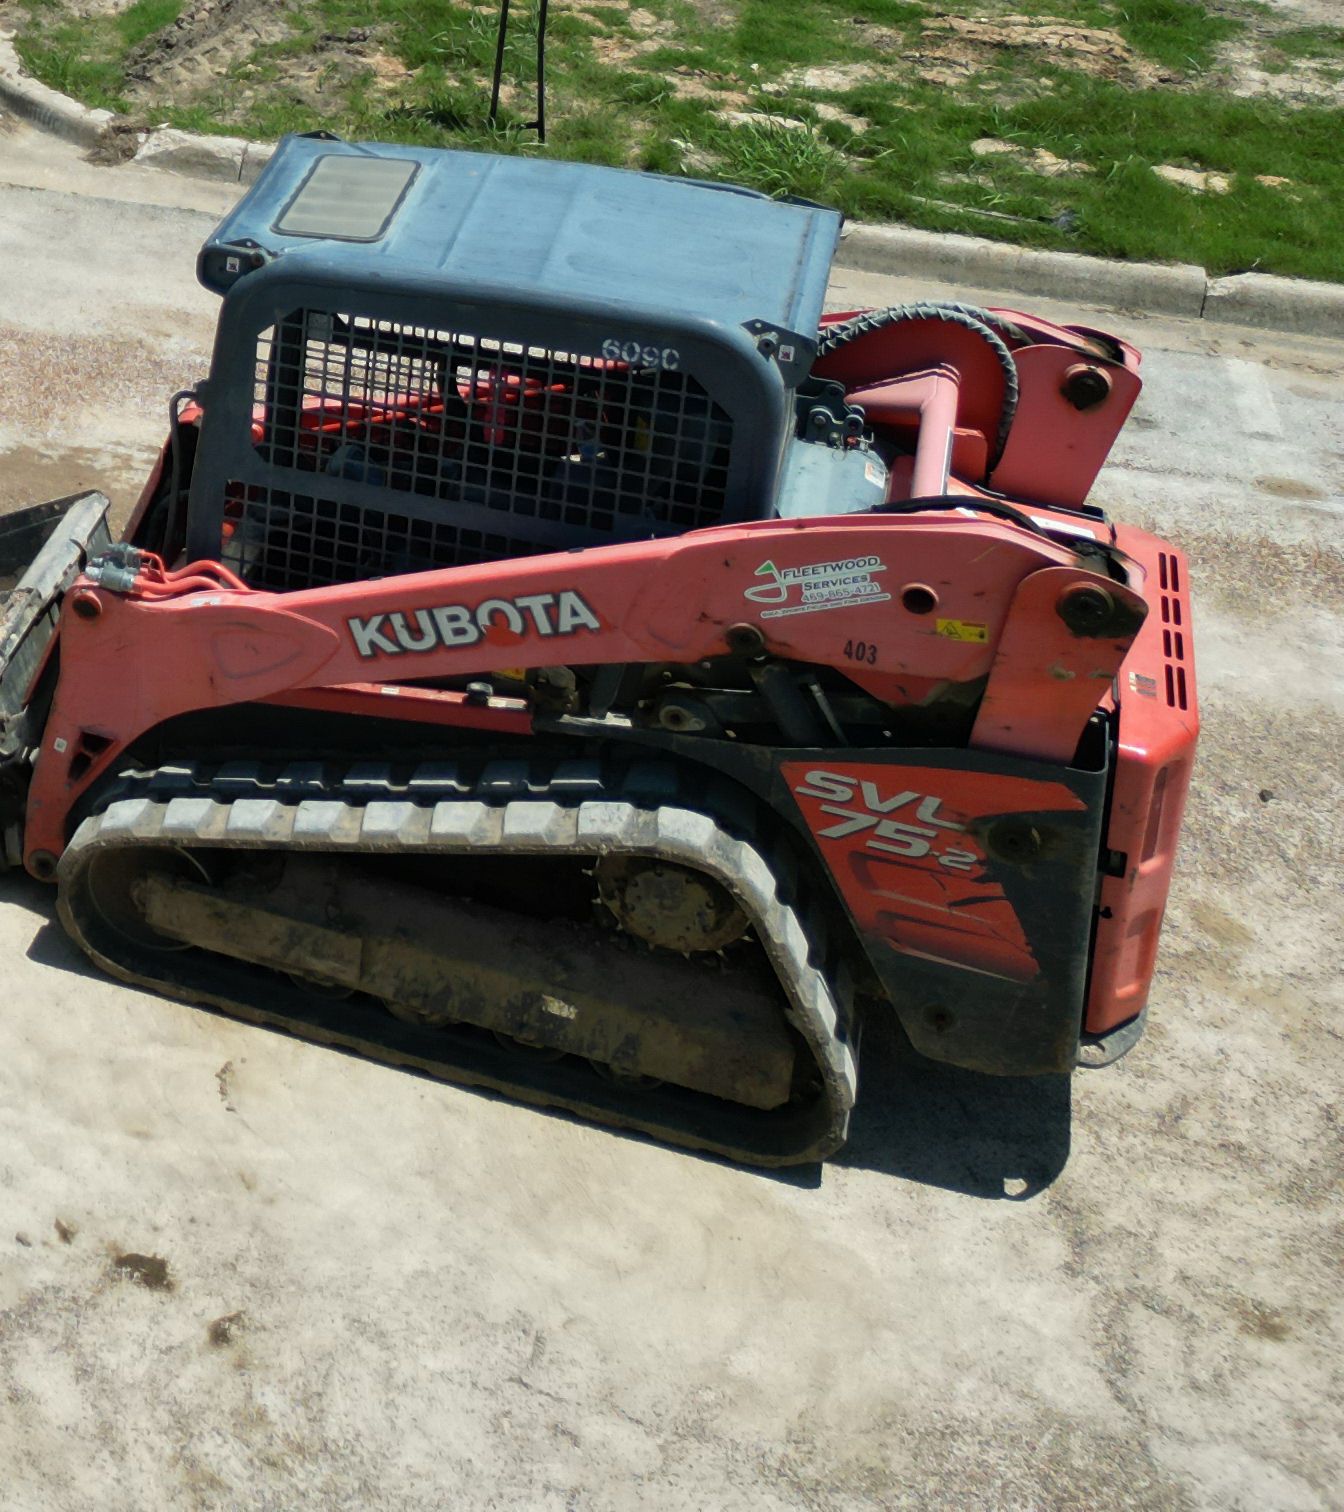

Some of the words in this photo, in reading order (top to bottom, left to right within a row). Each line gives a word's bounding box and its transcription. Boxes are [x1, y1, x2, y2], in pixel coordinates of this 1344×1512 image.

[783, 557, 878, 580] FLEETWOOD
[804, 574, 868, 591] SERVICES
[347, 590, 602, 657] KUBOTA
[843, 639, 878, 665] 403
[794, 770, 968, 832] SVL
